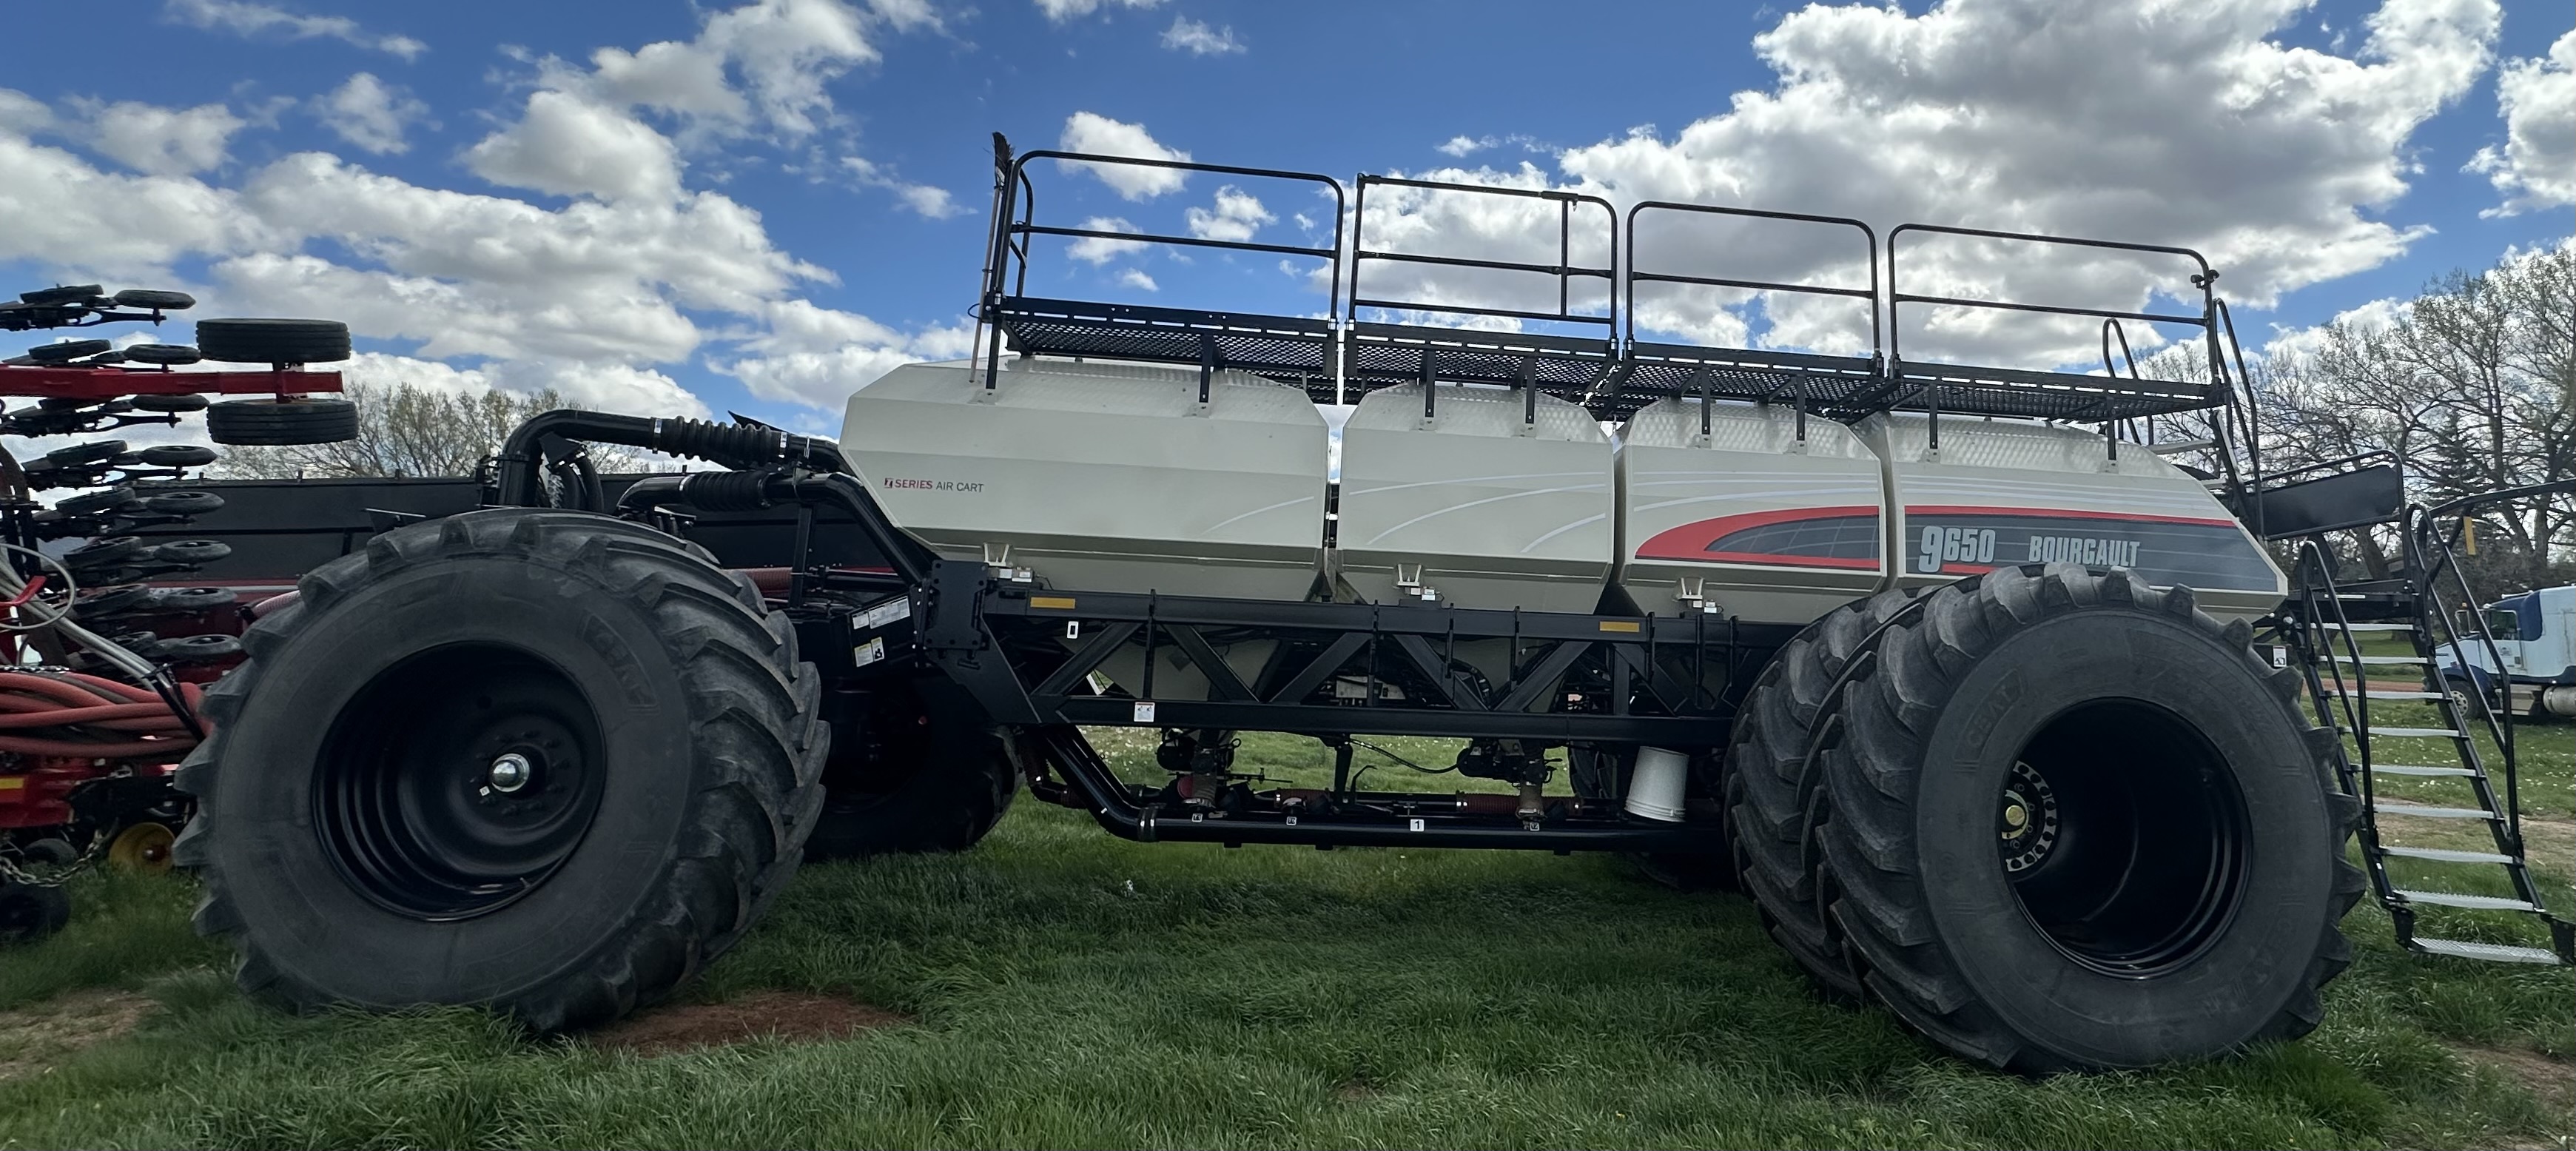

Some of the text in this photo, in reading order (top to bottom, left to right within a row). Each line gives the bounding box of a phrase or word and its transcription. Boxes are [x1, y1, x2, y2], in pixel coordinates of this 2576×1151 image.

[895, 479, 932, 489] SERIES
[936, 481, 953, 491] AIR
[956, 482, 984, 493] CART
[1918, 526, 1996, 573] 9650
[2028, 535, 2141, 567] BOURGAULT
[1414, 819, 1420, 830] 1
